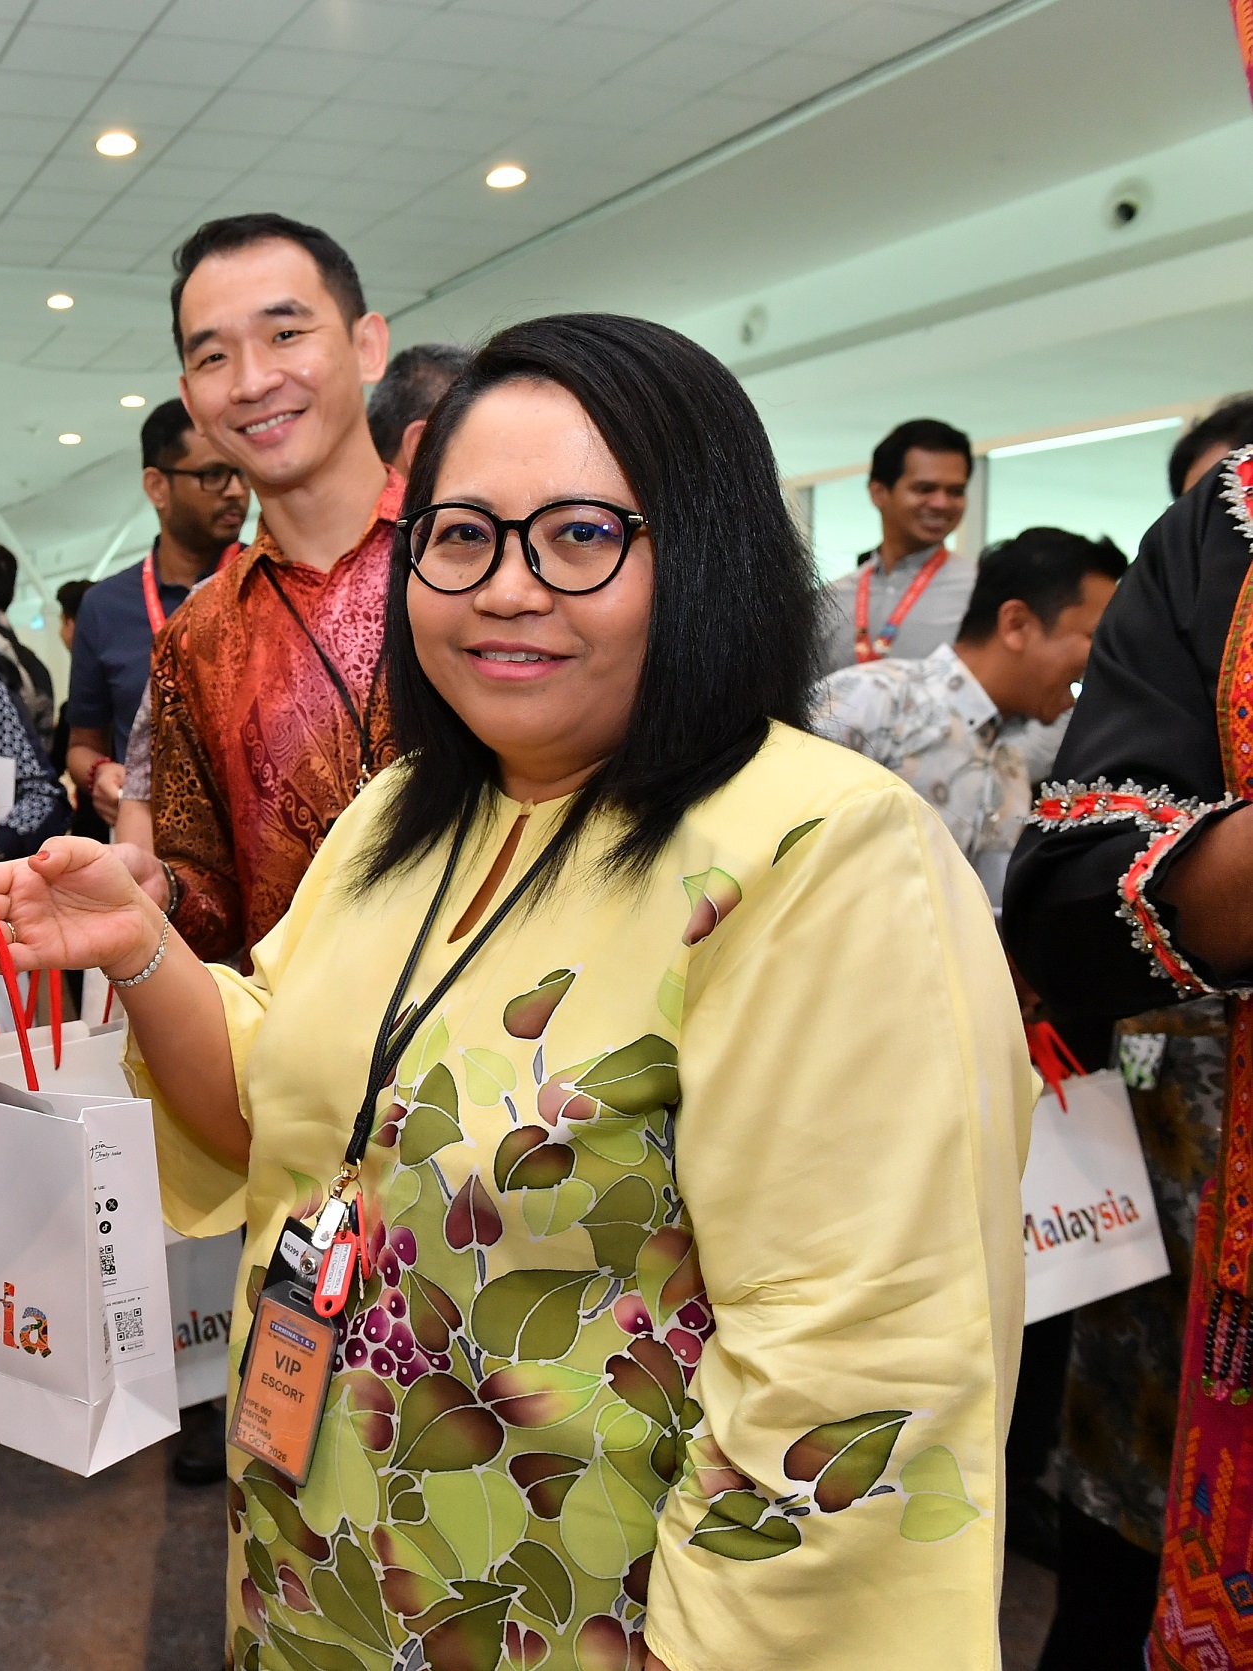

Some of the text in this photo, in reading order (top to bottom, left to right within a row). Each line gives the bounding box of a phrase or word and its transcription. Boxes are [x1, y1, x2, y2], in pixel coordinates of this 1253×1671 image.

[173, 1309, 234, 1352] alay
[271, 1322, 299, 1342] TERMINAL
[275, 1351, 302, 1376] VIP
[260, 1372, 305, 1404] ESCORT
[241, 1408, 268, 1427] VISITOR
[248, 1434, 267, 1450] OCT
[268, 1445, 287, 1463] 2026
